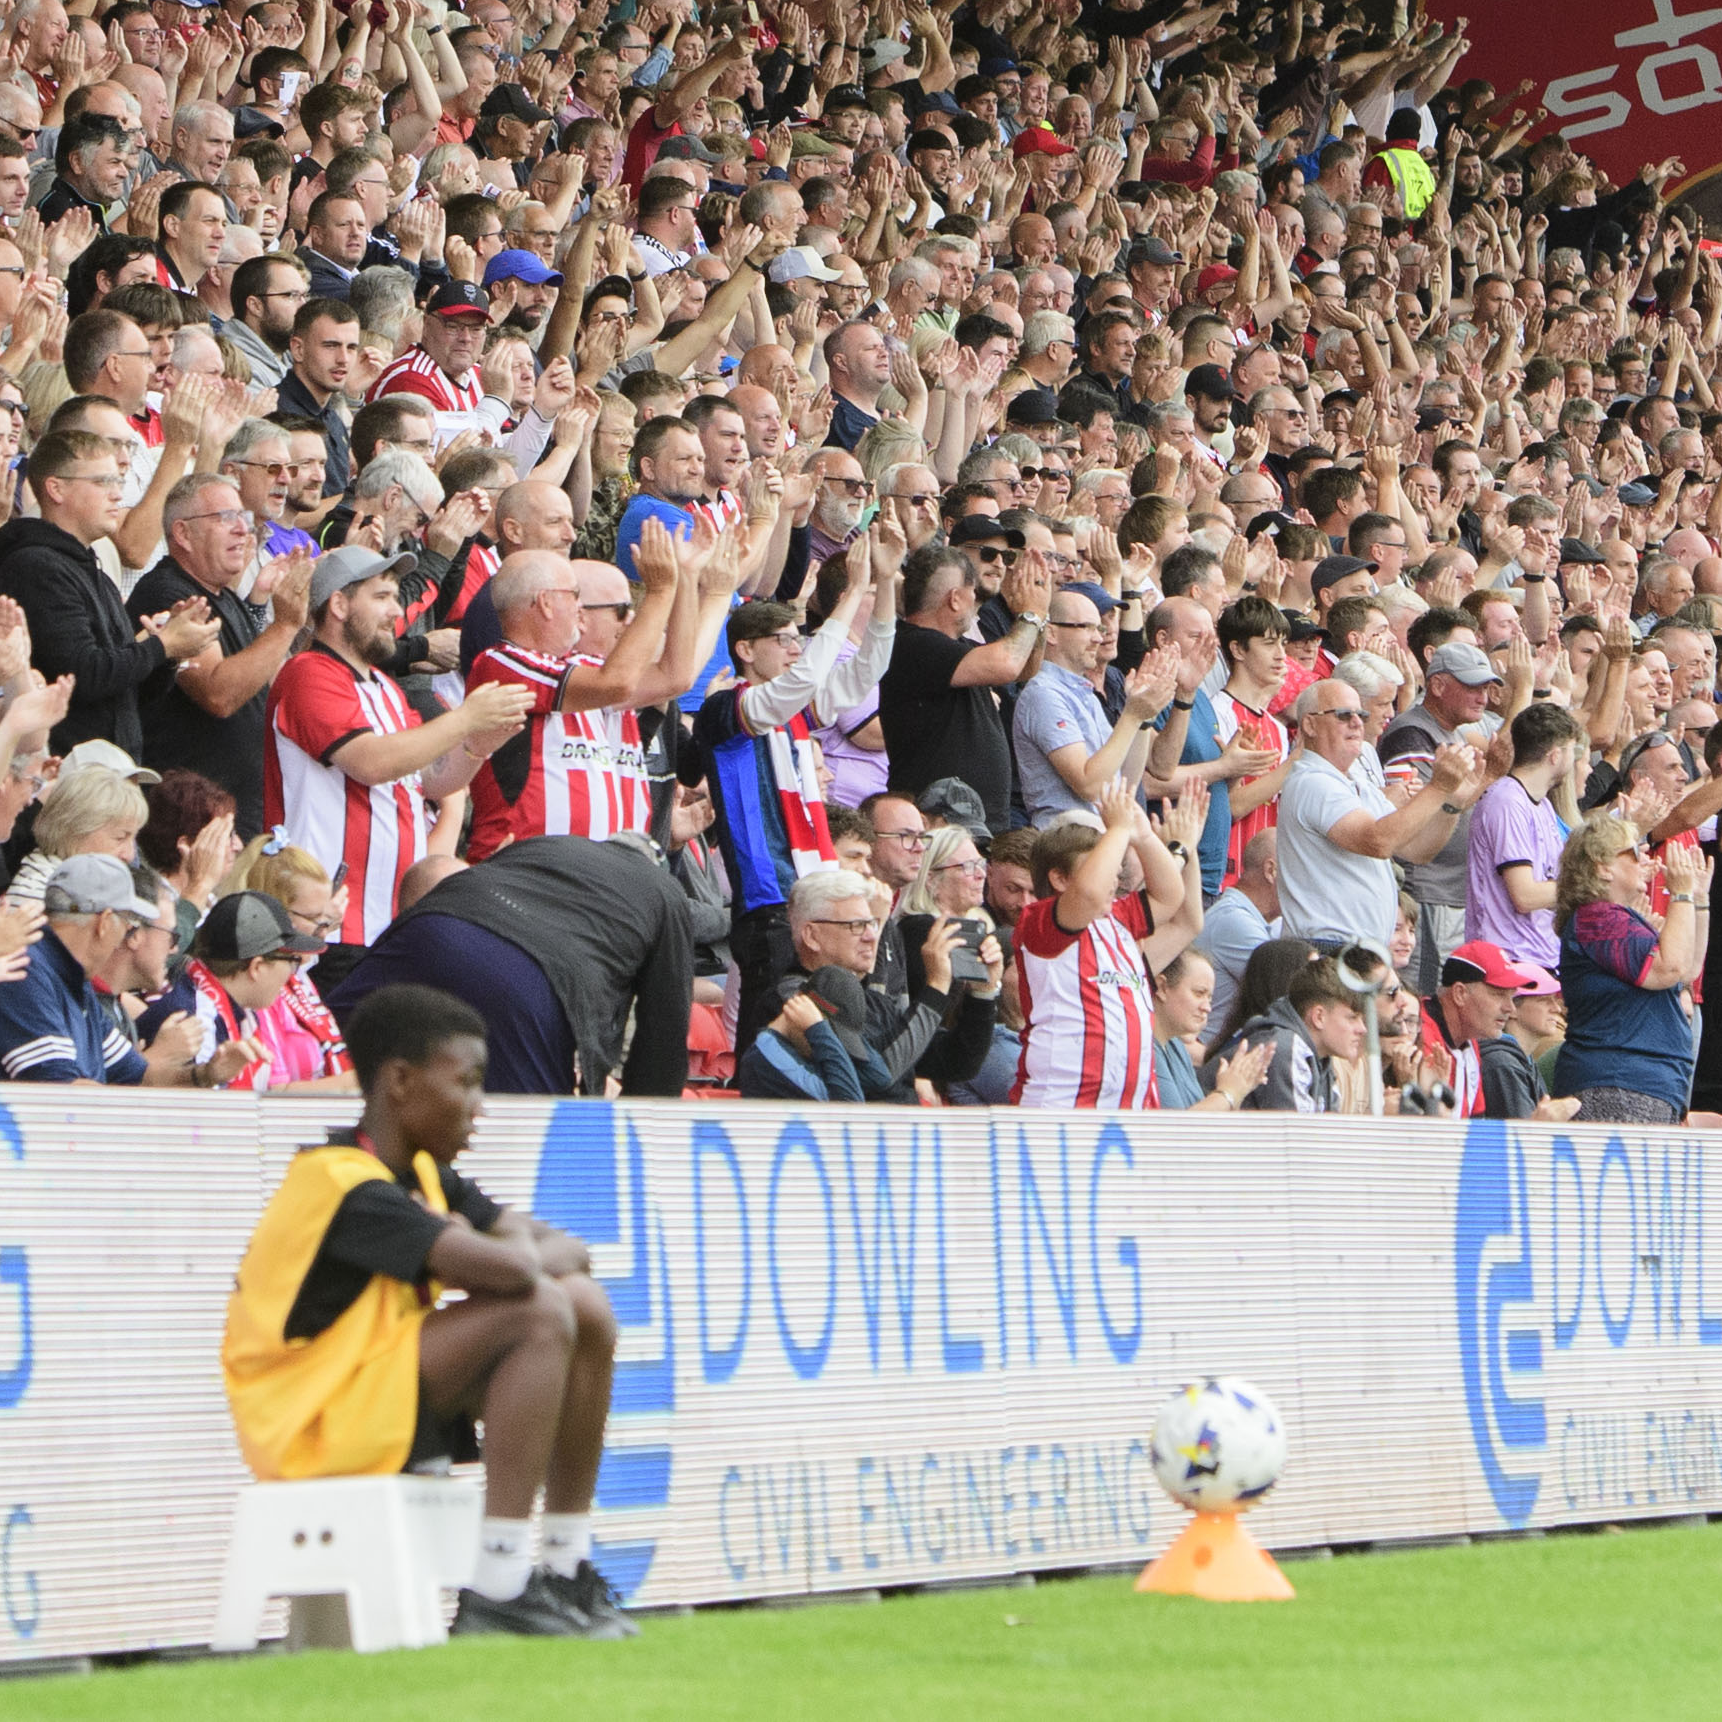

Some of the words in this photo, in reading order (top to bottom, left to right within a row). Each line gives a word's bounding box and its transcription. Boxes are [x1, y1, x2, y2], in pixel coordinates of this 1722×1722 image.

[690, 1114, 1142, 1384] DOWLING
[720, 1460, 843, 1582] CIVIL
[857, 1439, 1151, 1570] ENGINEERING
[1562, 1409, 1634, 1509] CIVIL
